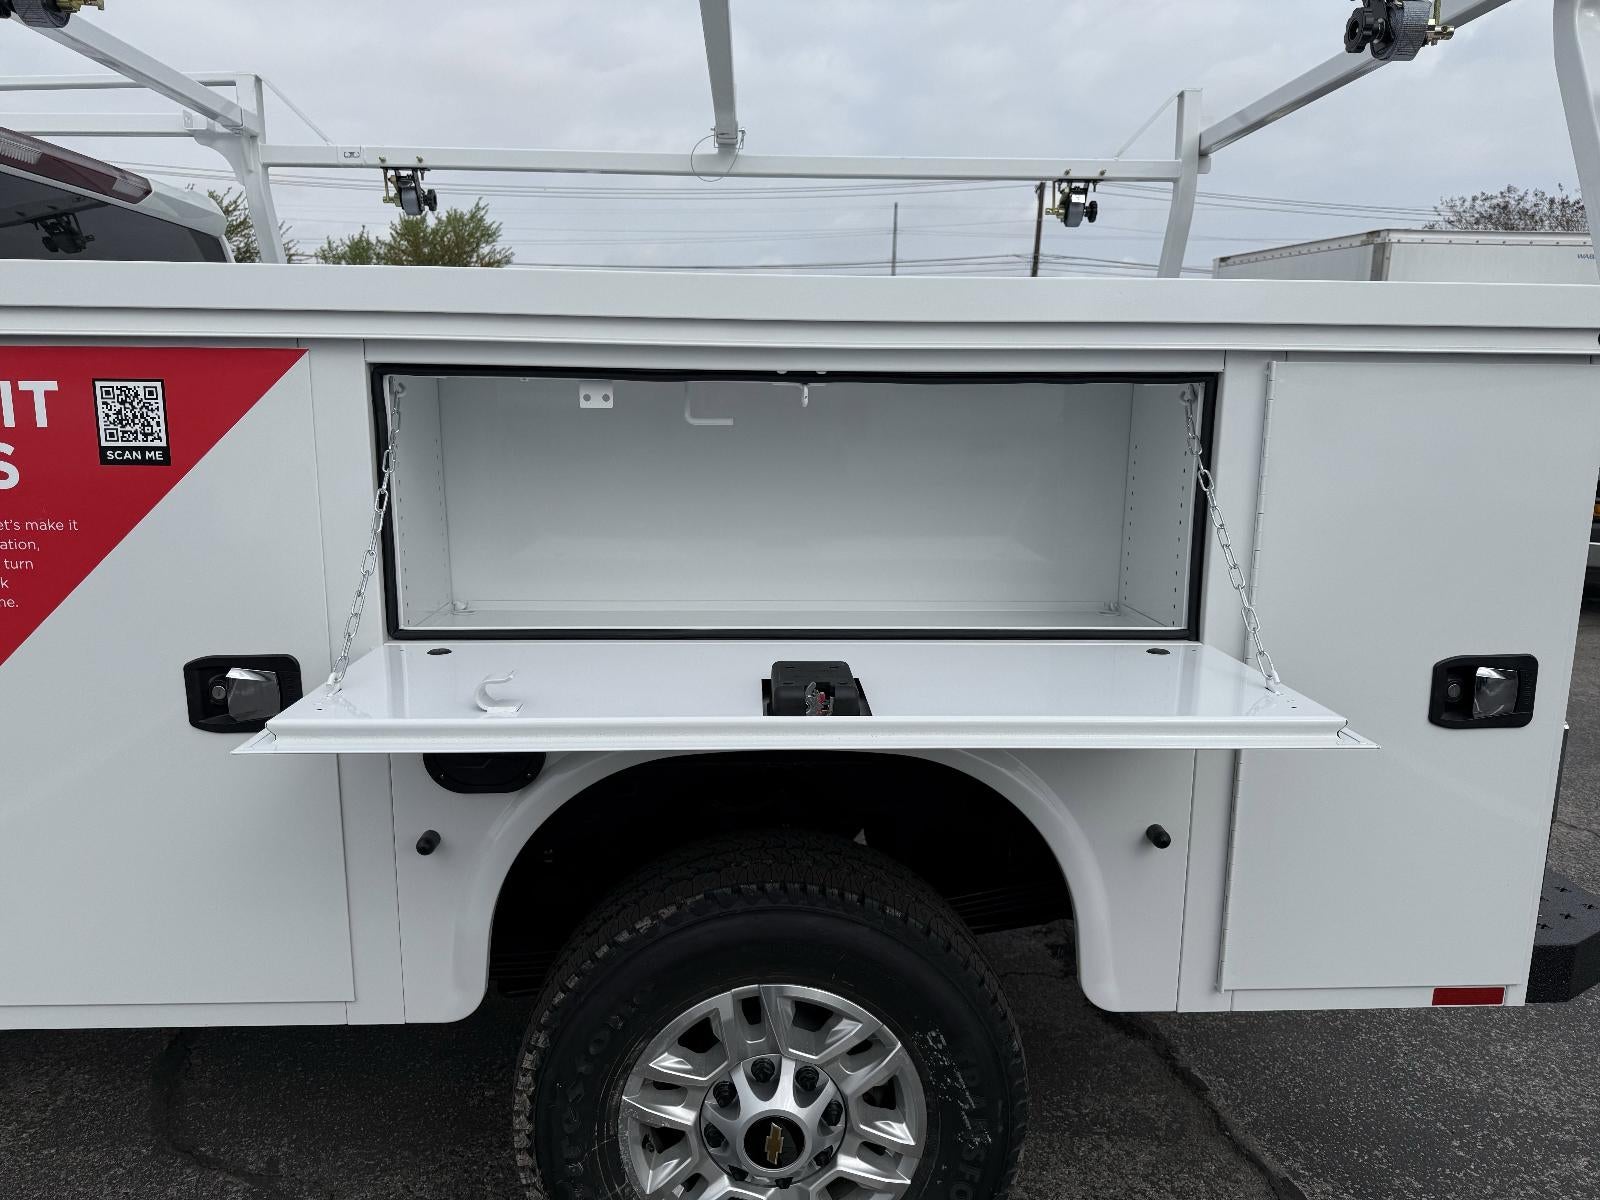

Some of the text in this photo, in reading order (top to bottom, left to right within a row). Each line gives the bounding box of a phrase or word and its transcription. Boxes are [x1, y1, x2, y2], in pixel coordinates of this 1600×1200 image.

[0, 381, 58, 427] IT
[106, 450, 164, 461] SCAN ME
[25, 518, 64, 531] make
[68, 519, 79, 531] it
[0, 538, 40, 552] ation,
[4, 558, 34, 570] turn
